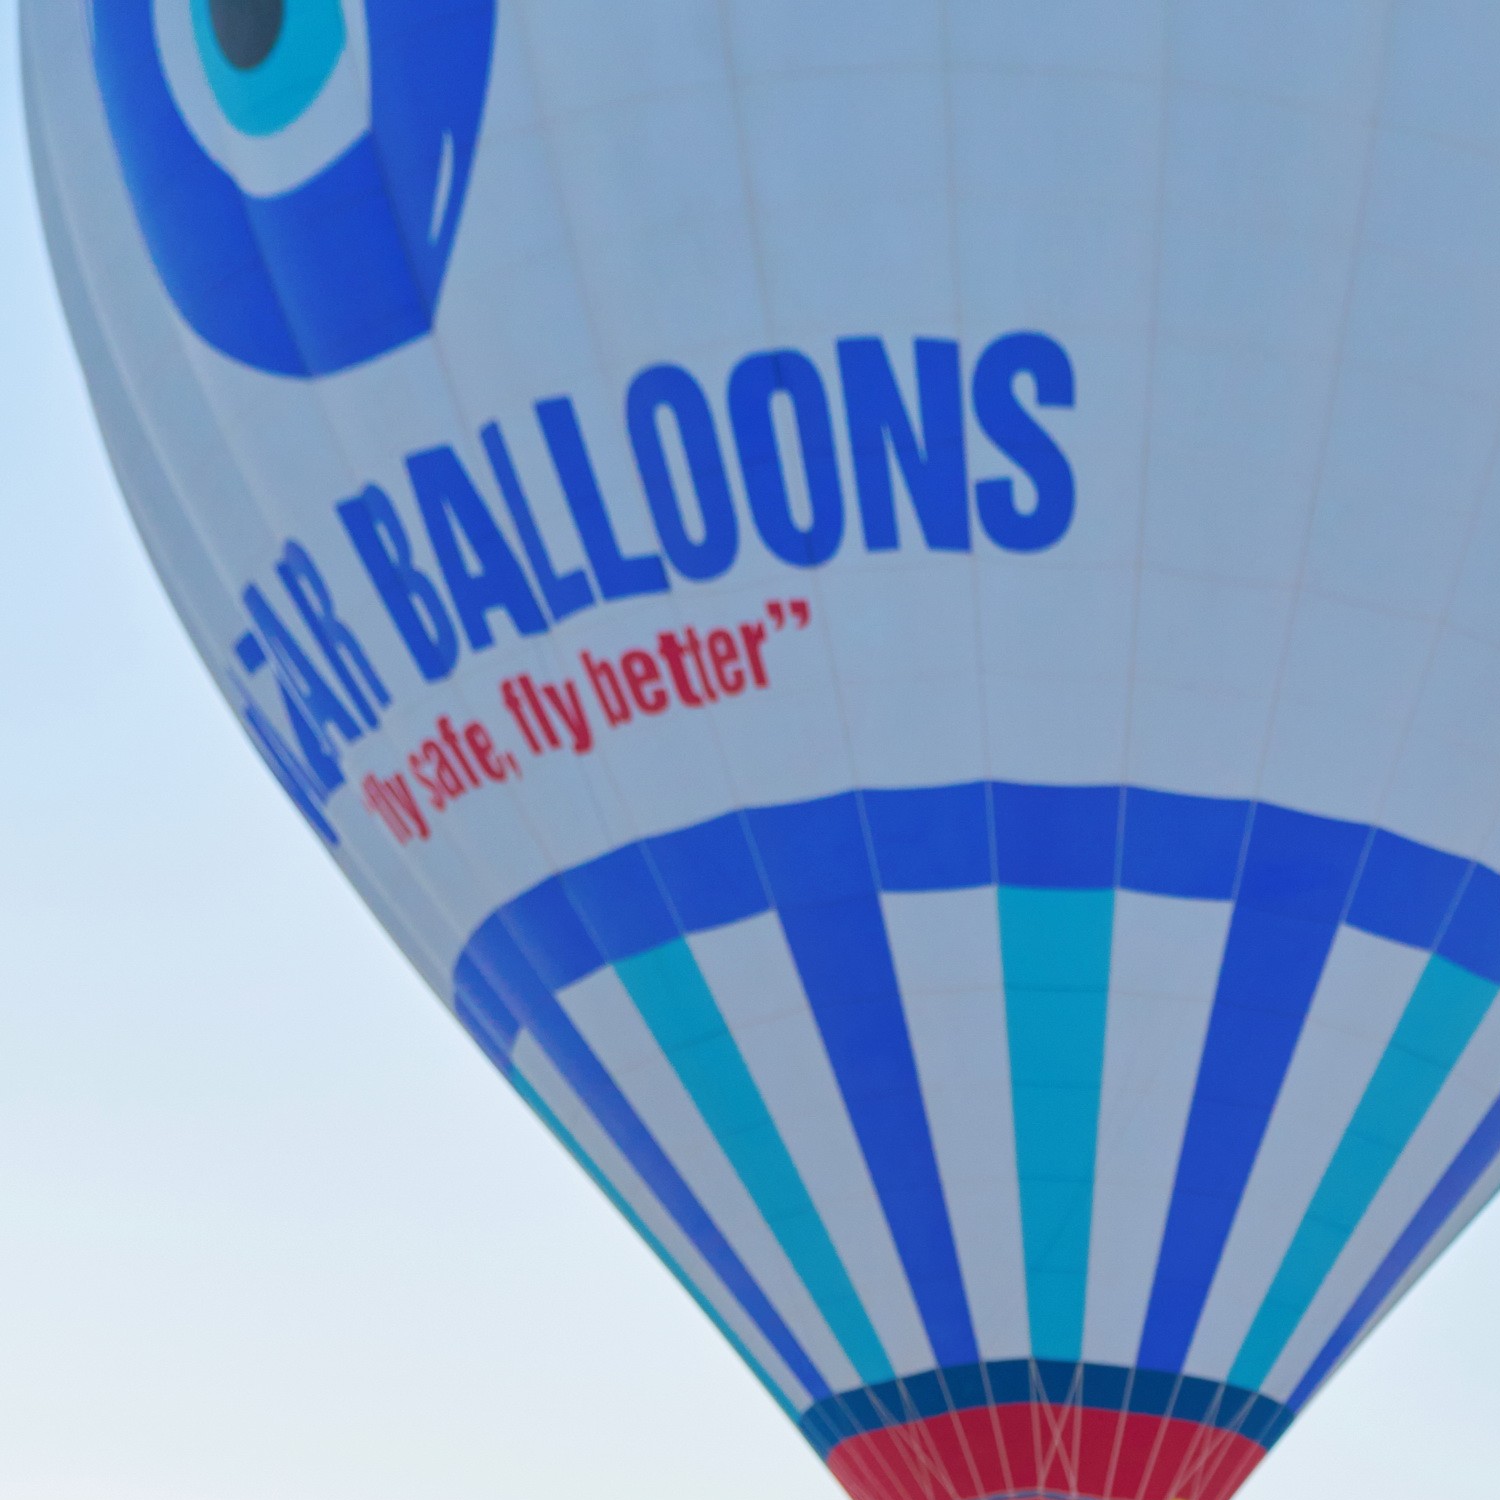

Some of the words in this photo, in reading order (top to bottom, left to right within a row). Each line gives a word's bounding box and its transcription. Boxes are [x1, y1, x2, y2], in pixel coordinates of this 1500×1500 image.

[228, 536, 392, 848] ZAR
[335, 329, 1077, 685] BALLOONS
[501, 672, 595, 757] fly
